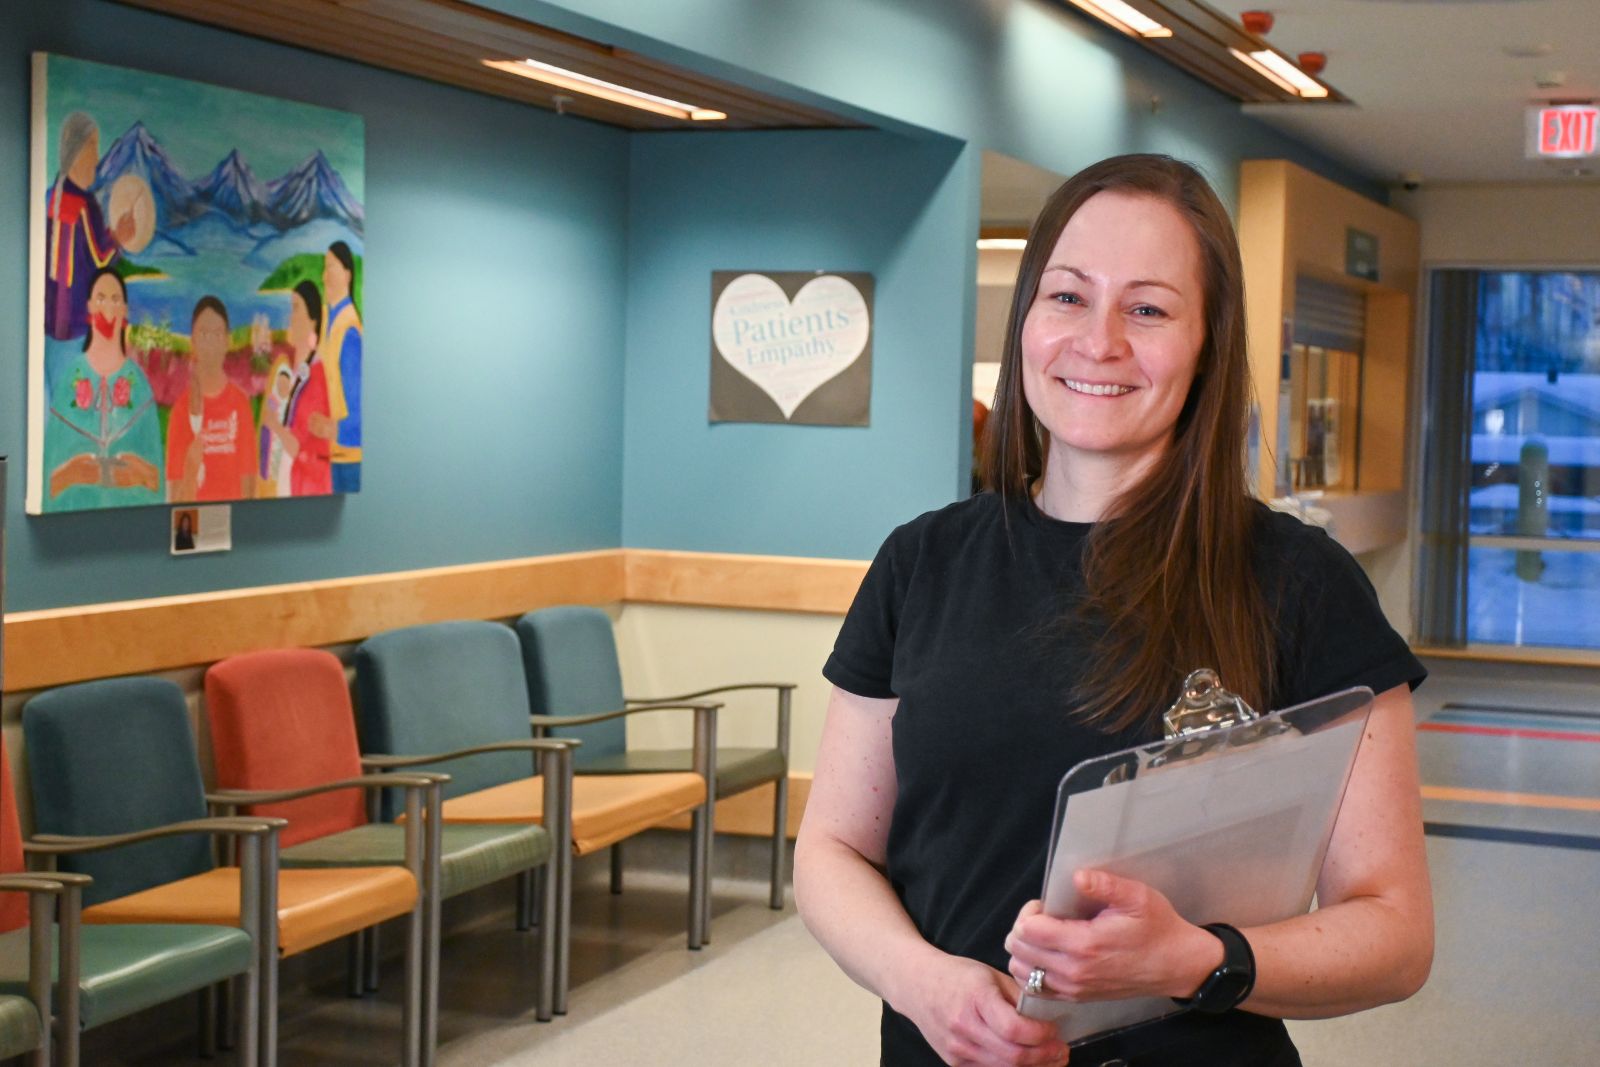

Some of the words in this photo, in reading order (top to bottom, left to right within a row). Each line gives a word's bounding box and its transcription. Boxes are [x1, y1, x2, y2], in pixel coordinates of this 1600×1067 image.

[1542, 111, 1597, 152] EXIT
[733, 309, 850, 347] Patients
[746, 336, 836, 366] Empathy
